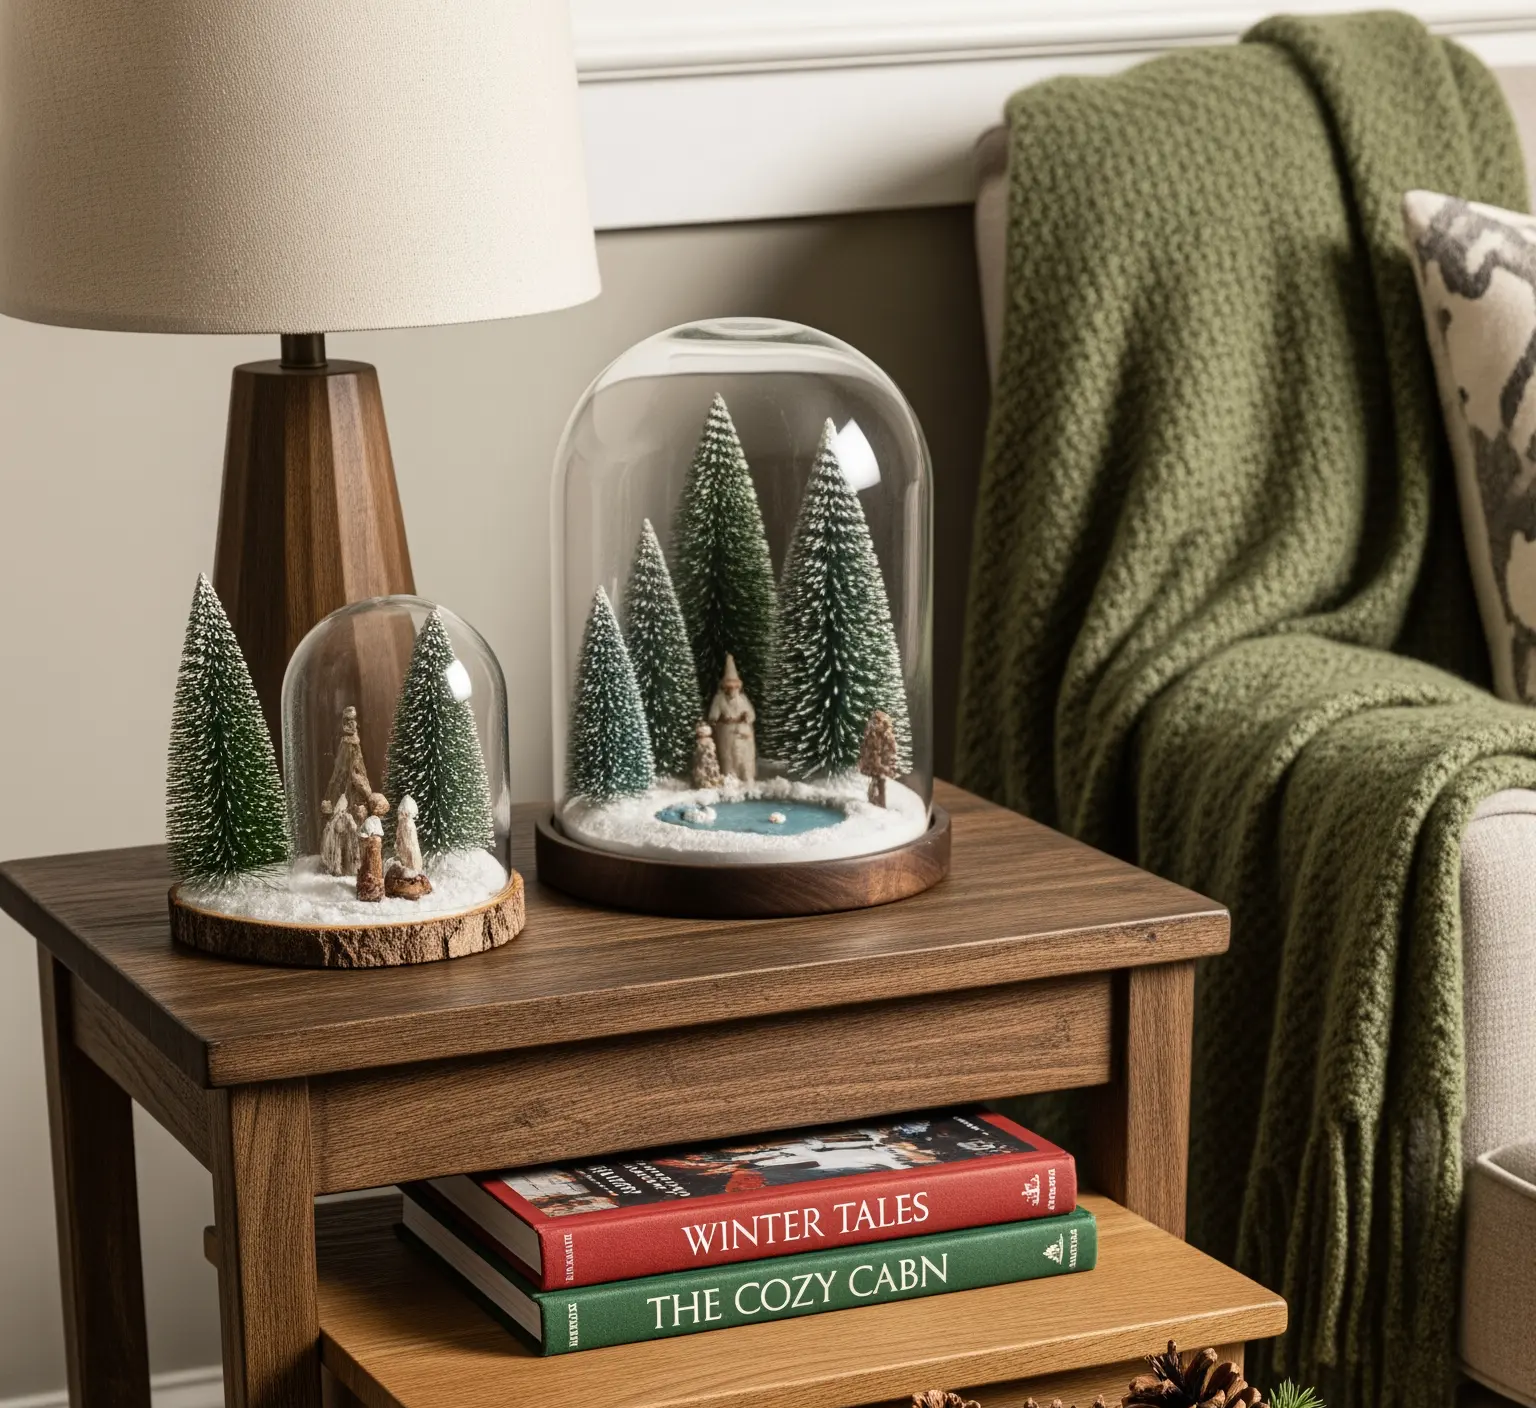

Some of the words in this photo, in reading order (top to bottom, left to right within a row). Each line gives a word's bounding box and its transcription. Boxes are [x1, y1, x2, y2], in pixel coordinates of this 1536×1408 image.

[681, 1207, 825, 1256] WINTER
[832, 1190, 930, 1235] TALES
[645, 1287, 723, 1331] THE
[733, 1270, 838, 1315] COZY
[847, 1252, 949, 1298] CABN
